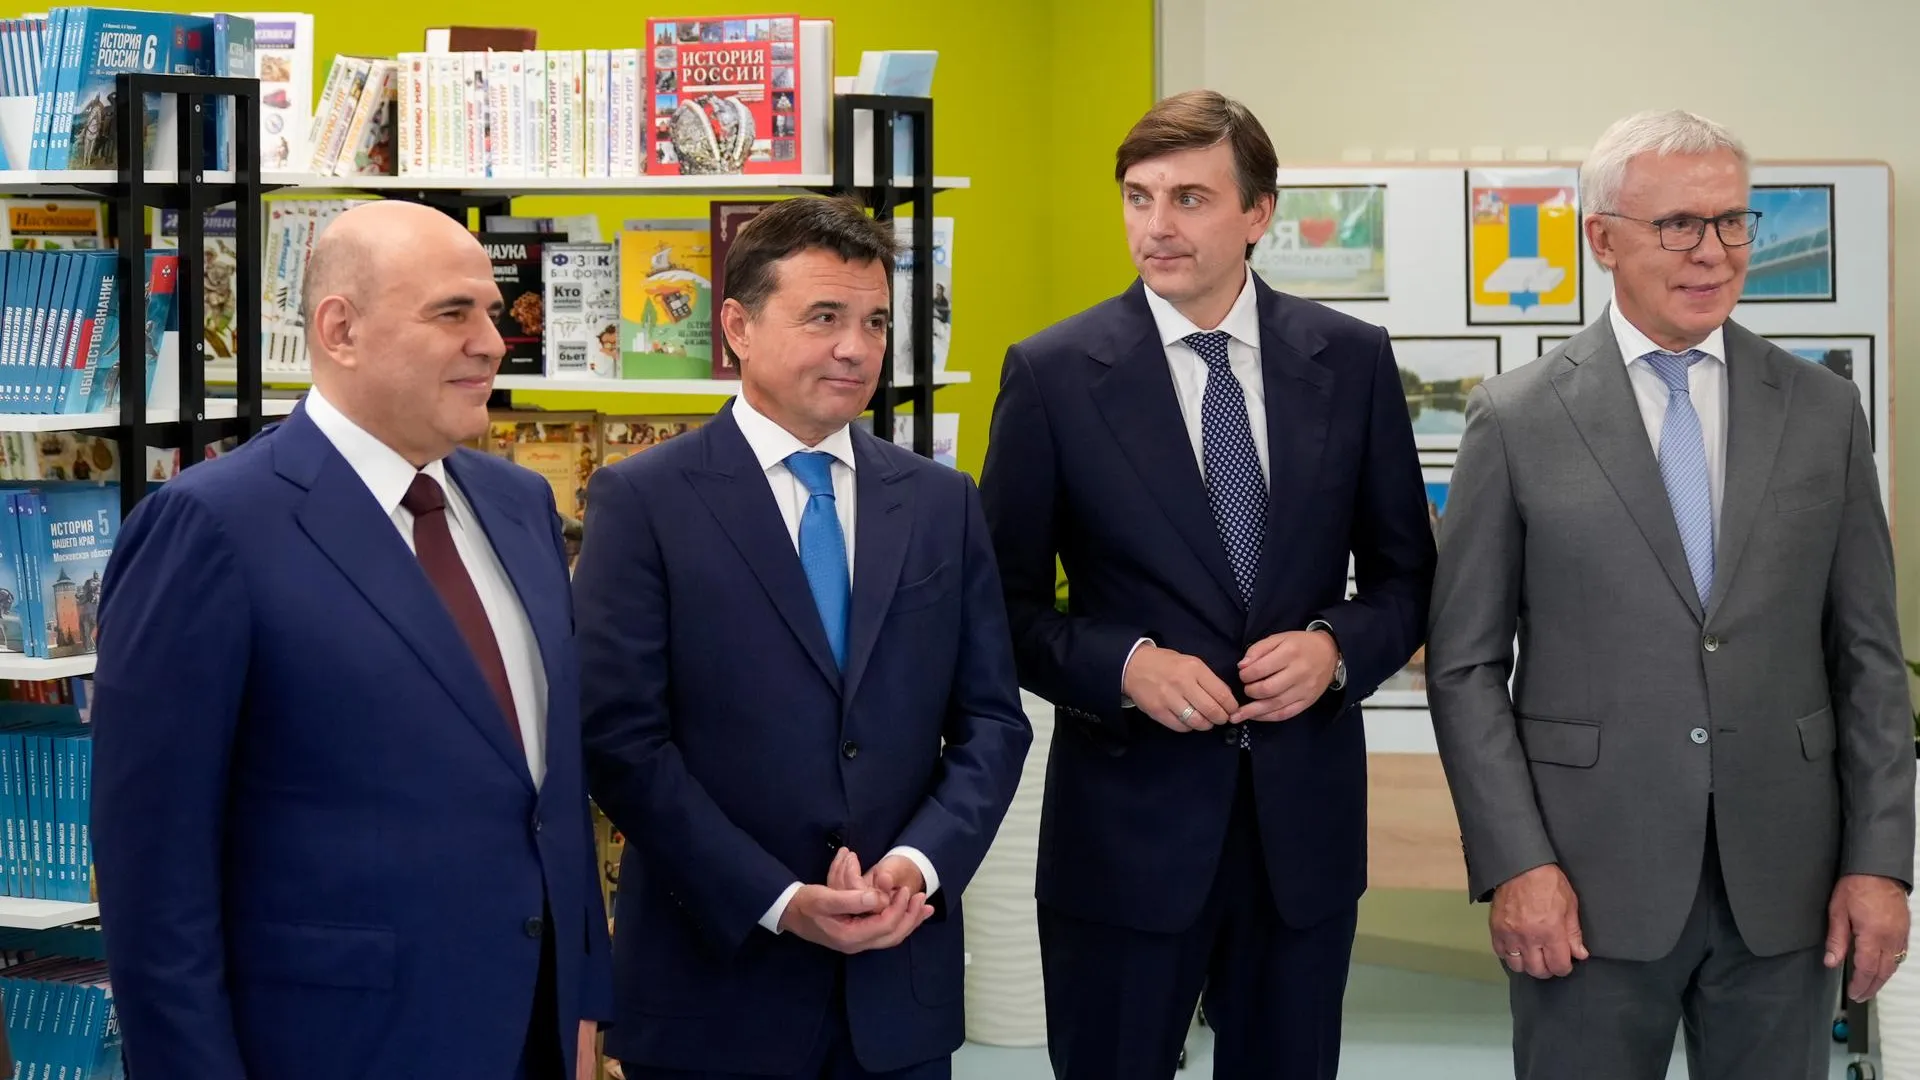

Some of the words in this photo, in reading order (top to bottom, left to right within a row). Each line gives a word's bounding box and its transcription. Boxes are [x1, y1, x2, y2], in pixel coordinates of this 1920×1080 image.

[100, 32, 142, 50] ИСТОРИЯ
[98, 48, 140, 68] РОССИИ
[144, 34, 158, 70] 6
[682, 50, 764, 66] ИСТОРИЯ
[682, 66, 764, 82] РОССИИ
[414, 80, 422, 103] МИР
[548, 79, 556, 106] МИР
[414, 108, 422, 157] ПОЗНАЮ
[548, 109, 557, 157] ПОЗНАЮ
[1275, 221, 1298, 251] Я
[554, 286, 580, 297] Кто
[79, 275, 115, 396] ОБЩЕСТВОЗНАНИЕ
[560, 352, 586, 360] бьет
[51, 520, 94, 536] ИСТОРИЯ
[98, 509, 110, 536] 5
[52, 537, 78, 549] НАШЕГО
[79, 536, 96, 546] КРАЯ
[54, 551, 89, 562] Московская
[91, 549, 113, 558] област
